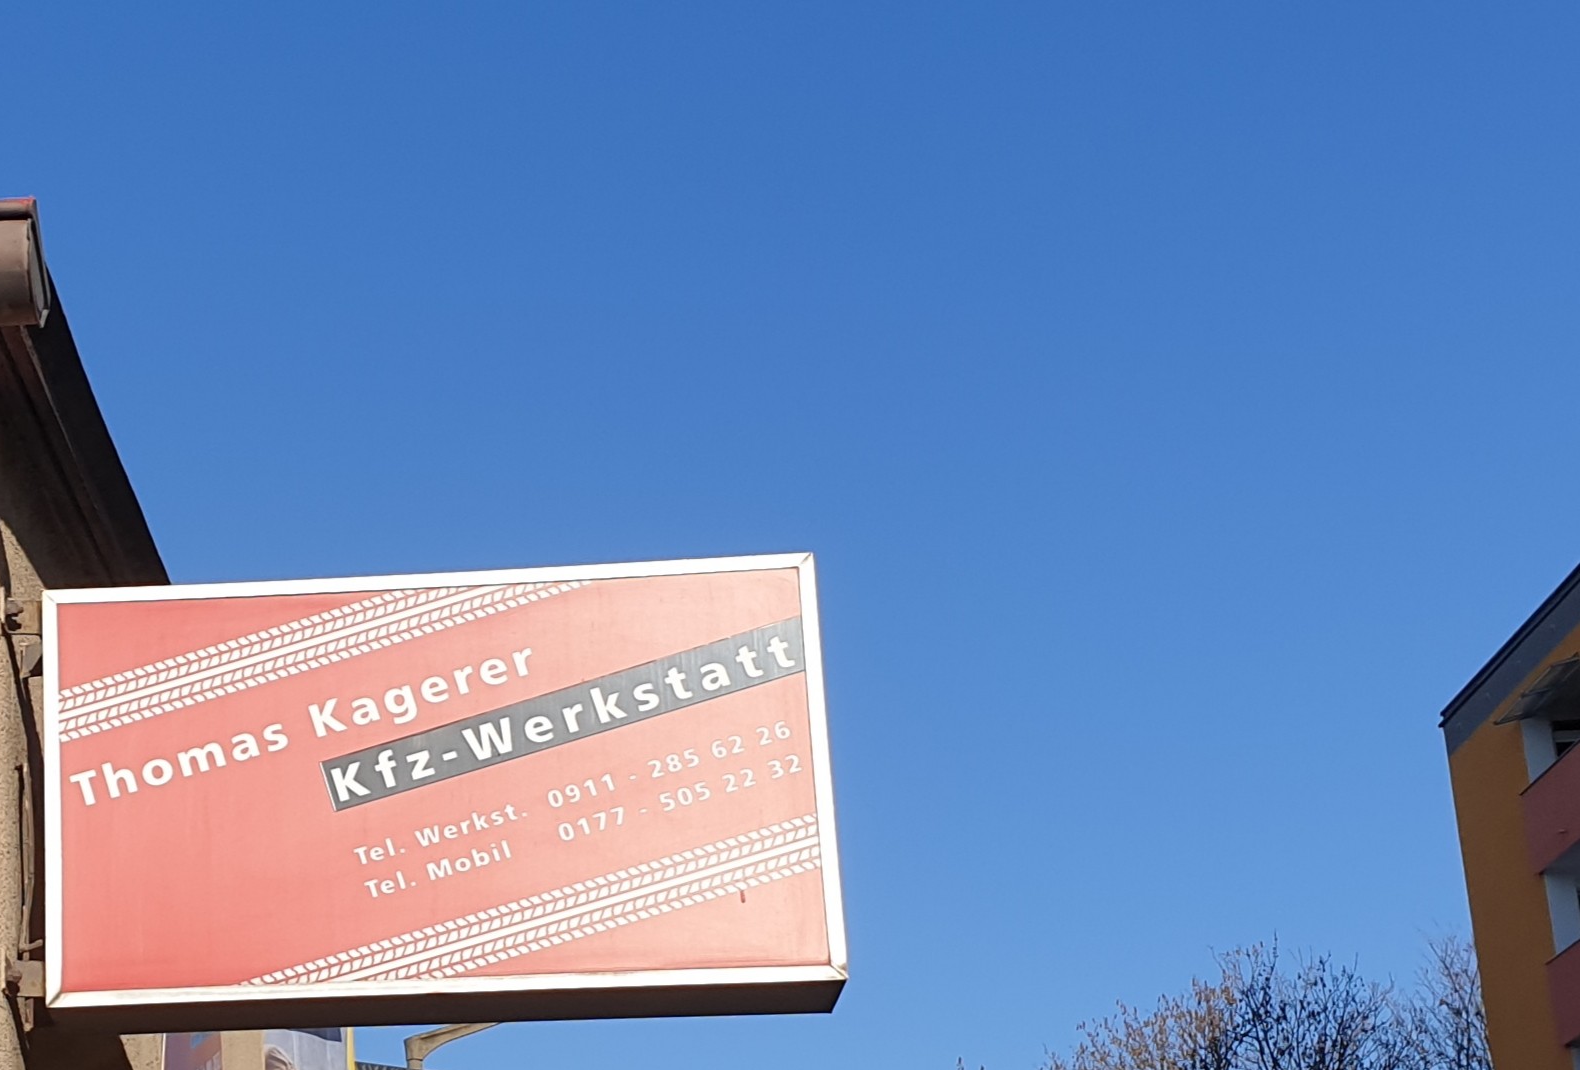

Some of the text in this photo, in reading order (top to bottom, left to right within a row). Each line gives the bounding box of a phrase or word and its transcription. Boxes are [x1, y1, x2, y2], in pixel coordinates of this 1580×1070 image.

[70, 646, 534, 806] Thomas Kagerer
[330, 634, 798, 803] Kfz-Werkstatt
[353, 837, 406, 866] Tel.
[414, 803, 528, 848] Werkst.
[547, 772, 617, 809] 0911
[647, 748, 701, 779] 285
[710, 734, 745, 760] 62
[756, 721, 791, 747] 26
[364, 870, 417, 899] Tel.
[426, 840, 513, 882] Mobil
[557, 806, 626, 842] 0177
[659, 781, 712, 812] 505
[722, 768, 757, 794] 22
[769, 753, 803, 780] 32
